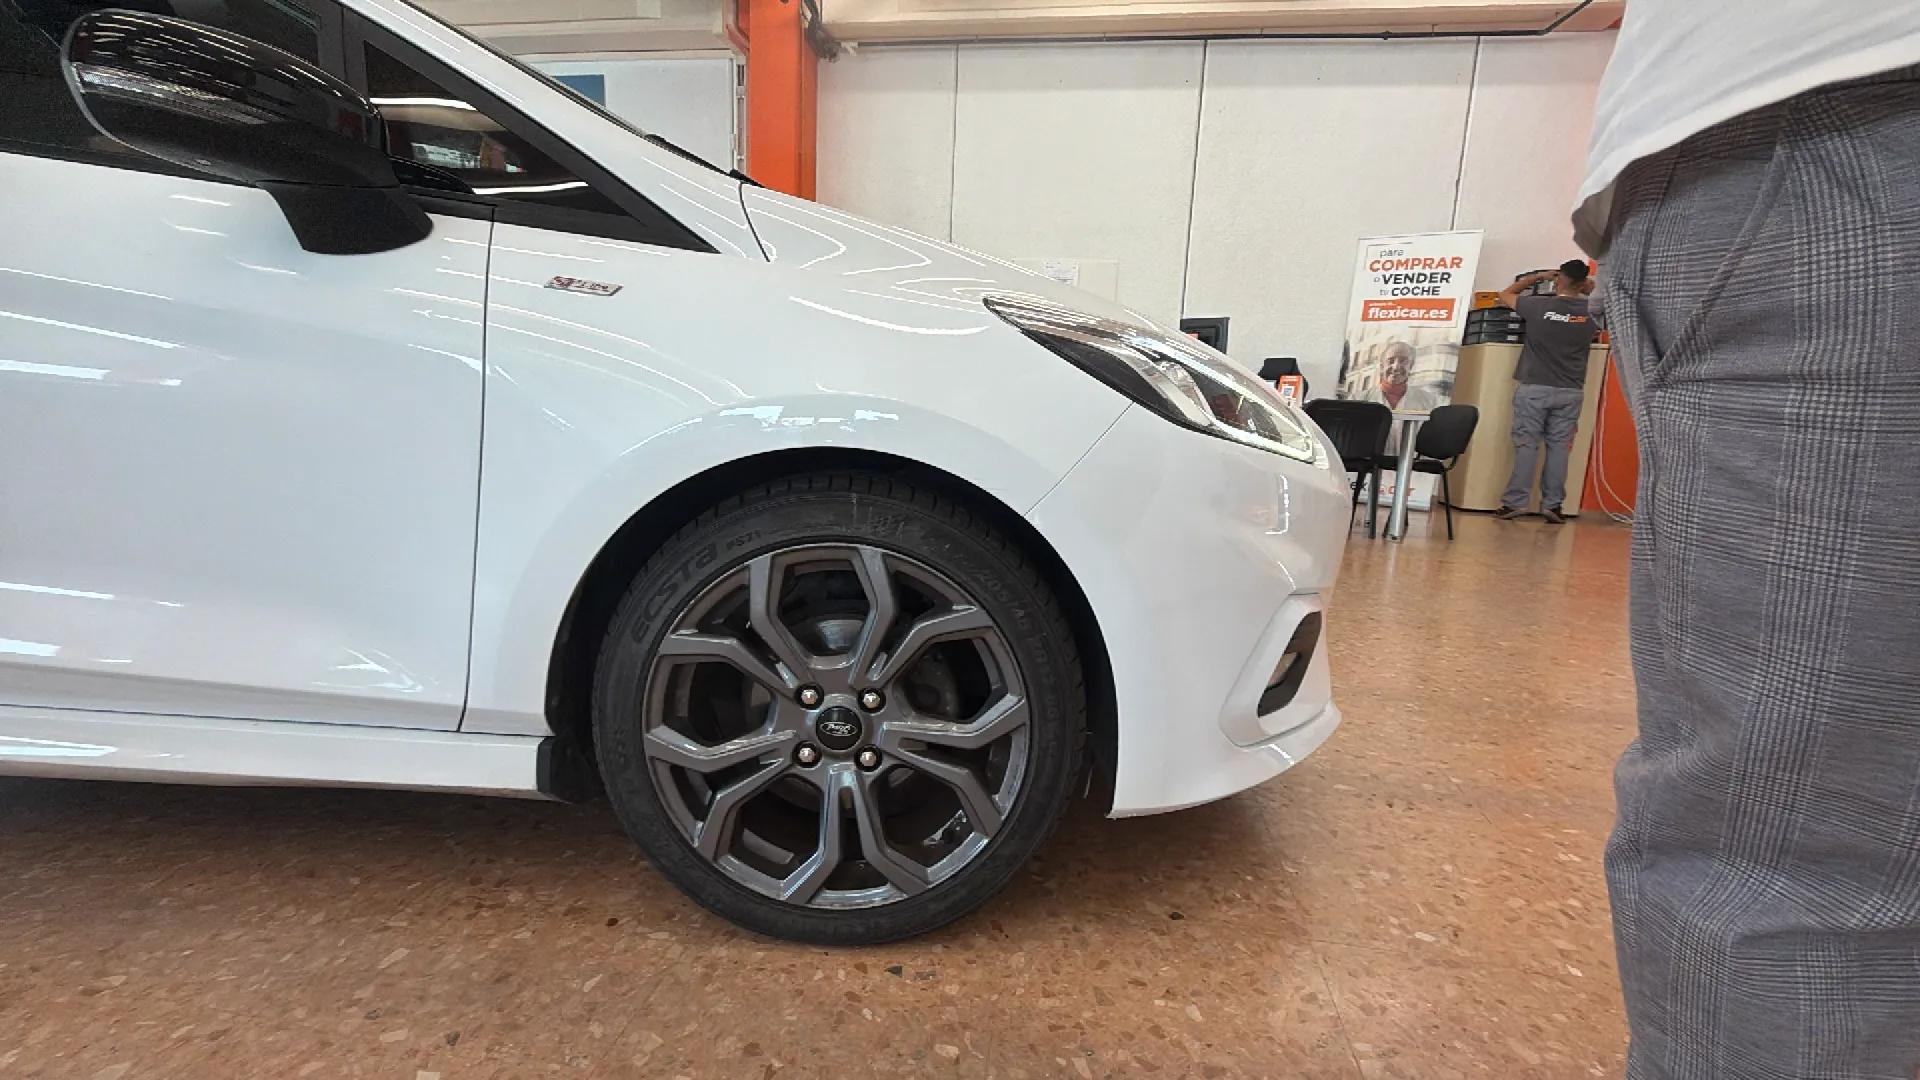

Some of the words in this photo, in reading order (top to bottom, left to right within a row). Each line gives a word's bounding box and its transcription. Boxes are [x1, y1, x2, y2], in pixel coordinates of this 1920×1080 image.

[1380, 249, 1404, 258] para
[1369, 256, 1464, 273] COMPRAR
[1382, 272, 1452, 285] VENDER
[1391, 286, 1441, 297] COCHE
[1367, 306, 1449, 319] flexicar.es
